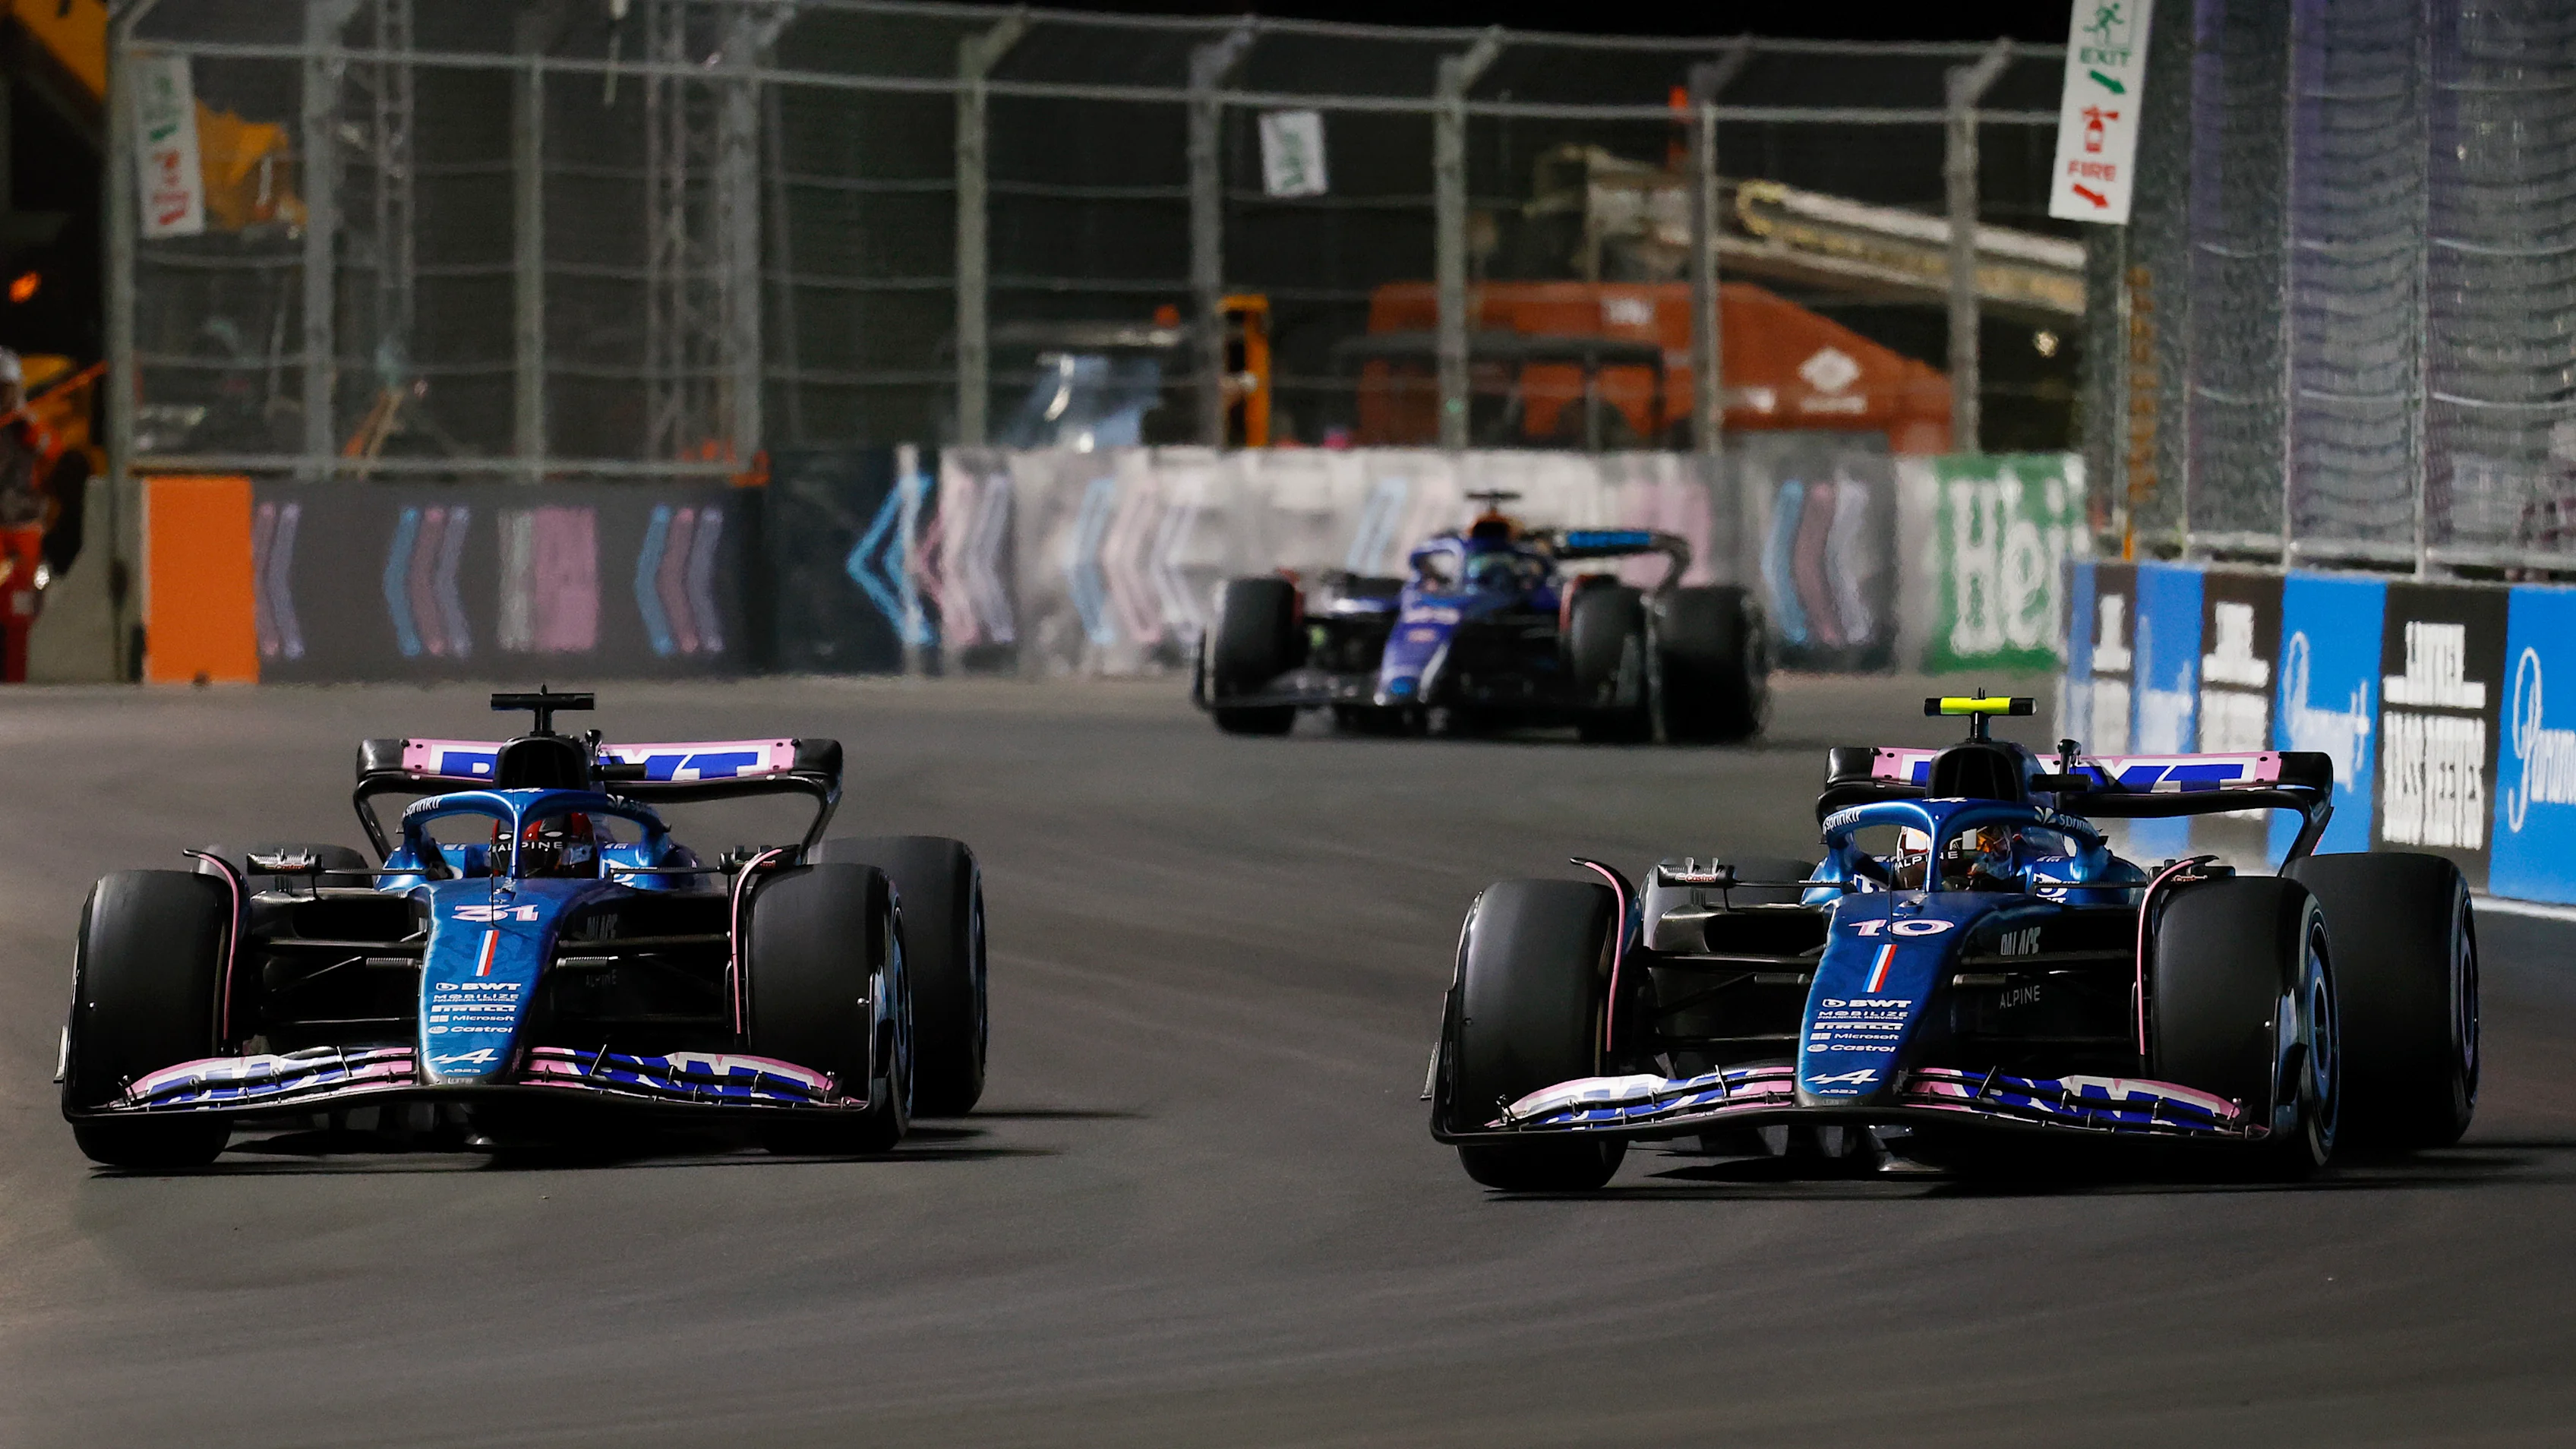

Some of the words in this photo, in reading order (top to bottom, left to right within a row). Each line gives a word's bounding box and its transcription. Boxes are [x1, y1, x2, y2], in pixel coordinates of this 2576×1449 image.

[2079, 46, 2132, 67] EXIT
[2067, 159, 2117, 182] FIRE
[451, 904, 538, 923] 31
[1848, 919, 1955, 936] 10
[461, 983, 522, 991] BWT
[1848, 999, 1912, 1008] BWT
[1999, 985, 2041, 1009] ALPINE
[431, 1004, 517, 1012] PIRELLI
[1814, 1021, 1904, 1031] PIRELLI
[1830, 1044, 1896, 1053] Castrol
